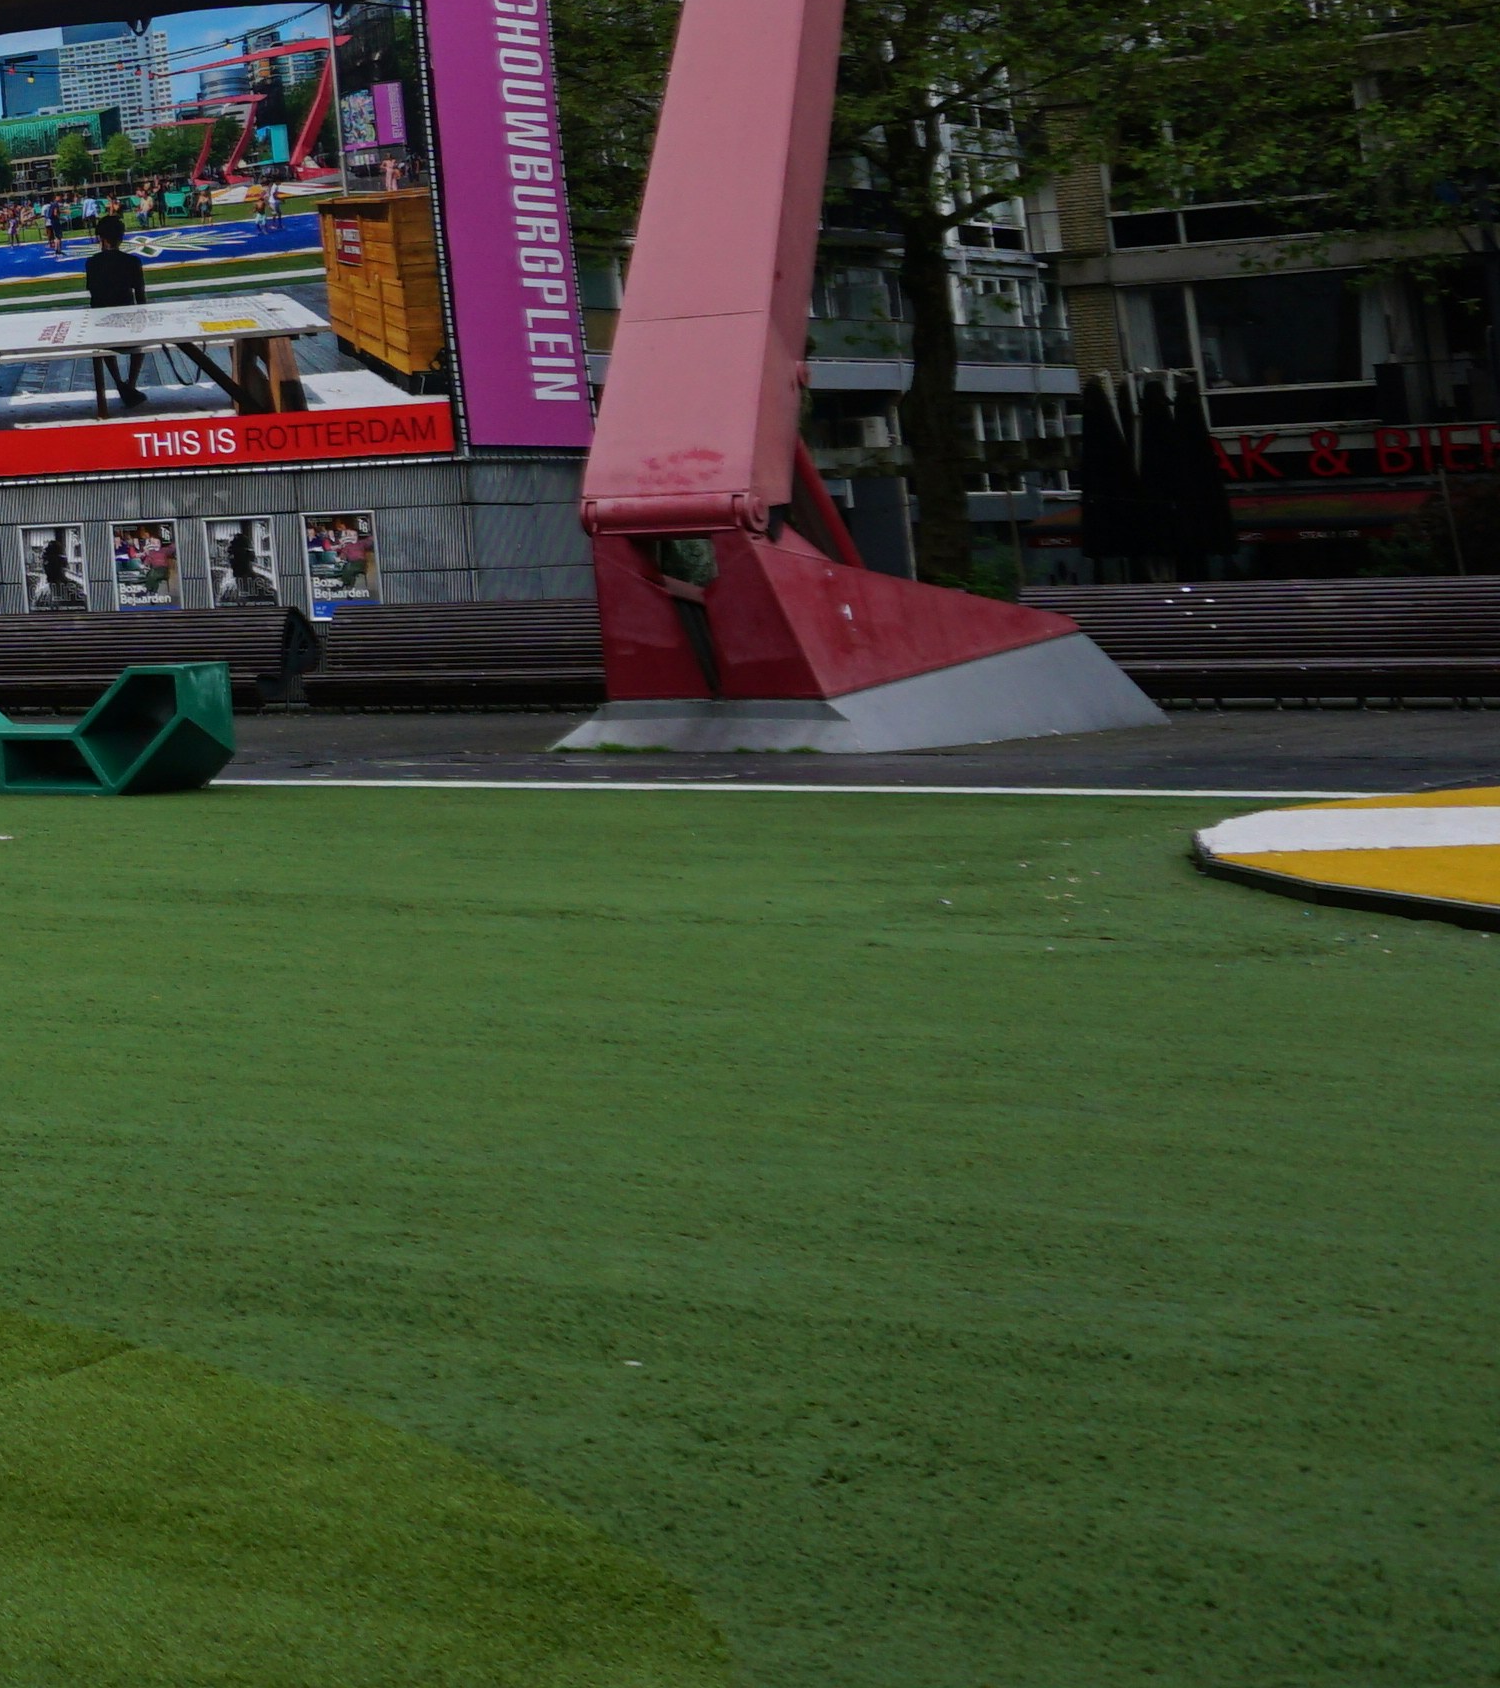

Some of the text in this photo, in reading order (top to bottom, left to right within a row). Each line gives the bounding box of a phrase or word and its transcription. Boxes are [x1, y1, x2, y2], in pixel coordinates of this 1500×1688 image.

[133, 415, 438, 458] THIS IS ROTTERDAM
[1308, 429, 1353, 478] &
